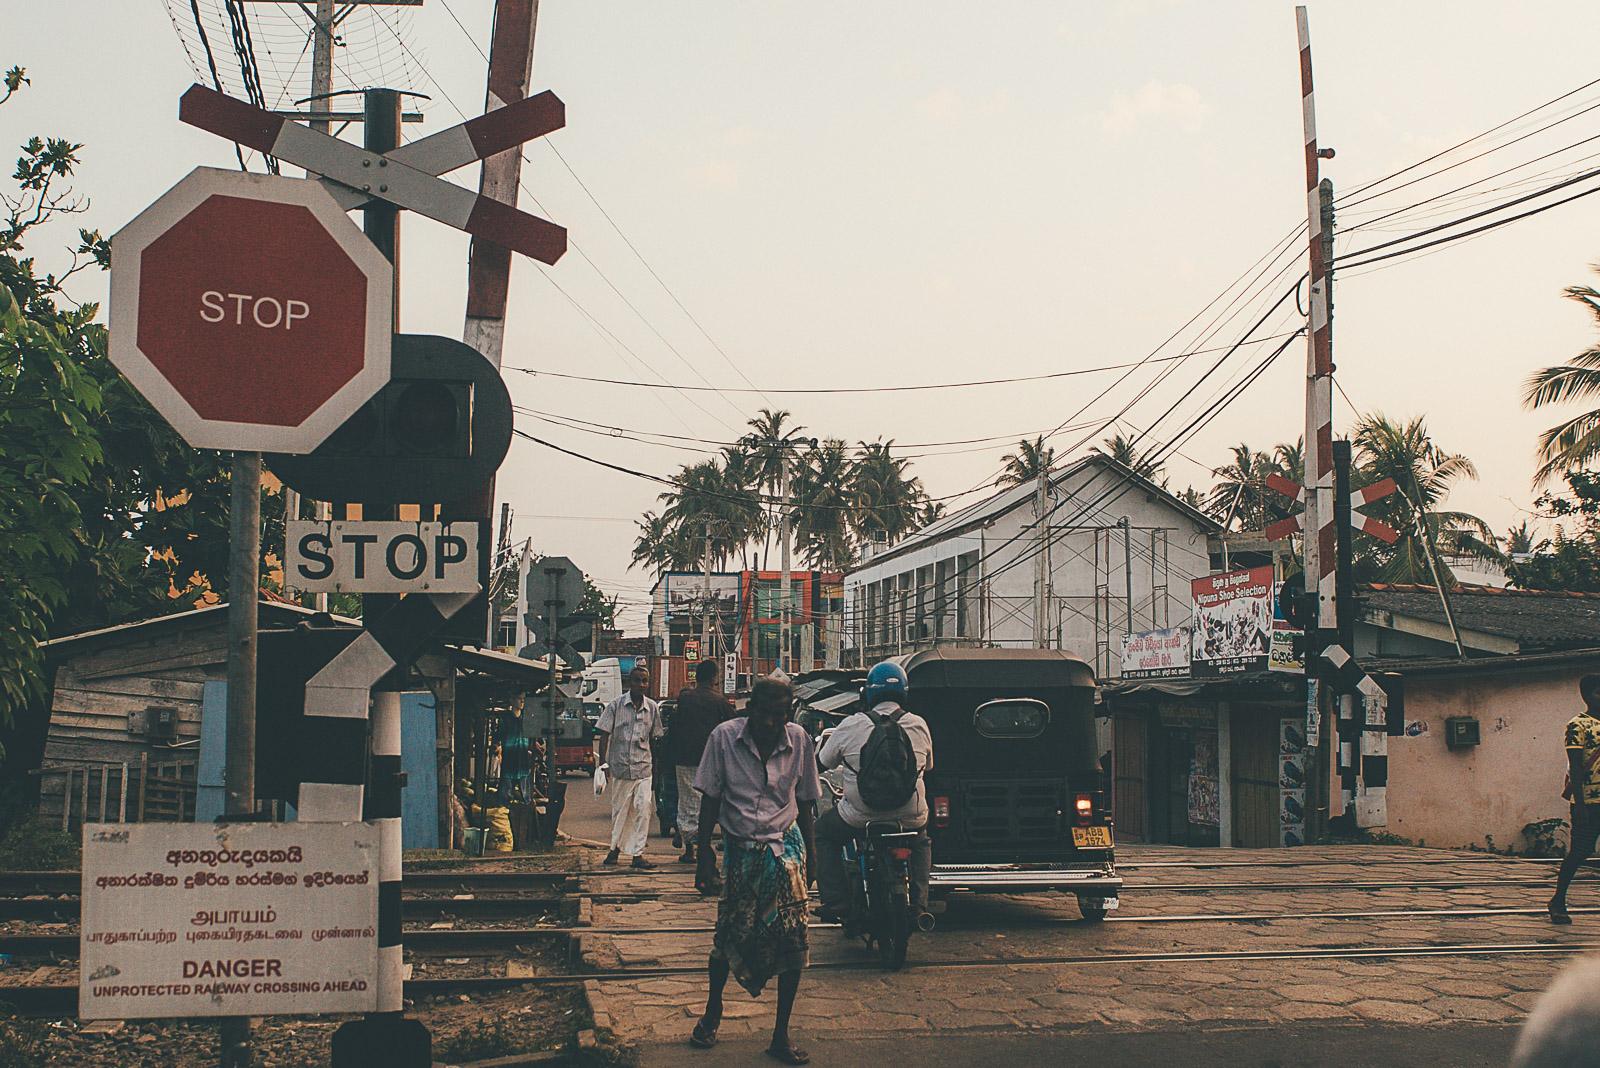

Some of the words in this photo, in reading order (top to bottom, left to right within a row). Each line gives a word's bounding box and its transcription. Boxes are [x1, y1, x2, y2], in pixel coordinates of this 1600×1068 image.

[199, 290, 310, 330] STOP
[298, 533, 468, 580] STOP
[1219, 590, 1235, 601] Shoe
[1235, 584, 1267, 597] Selection
[190, 905, 277, 926] அபாயம்
[312, 925, 376, 942] முன்னால்
[182, 959, 282, 979] DANGER
[93, 984, 191, 998] UNPROTECTED
[194, 983, 250, 995] RAILWAY
[253, 981, 320, 994] CROSSING
[323, 980, 367, 992] AHEAD
